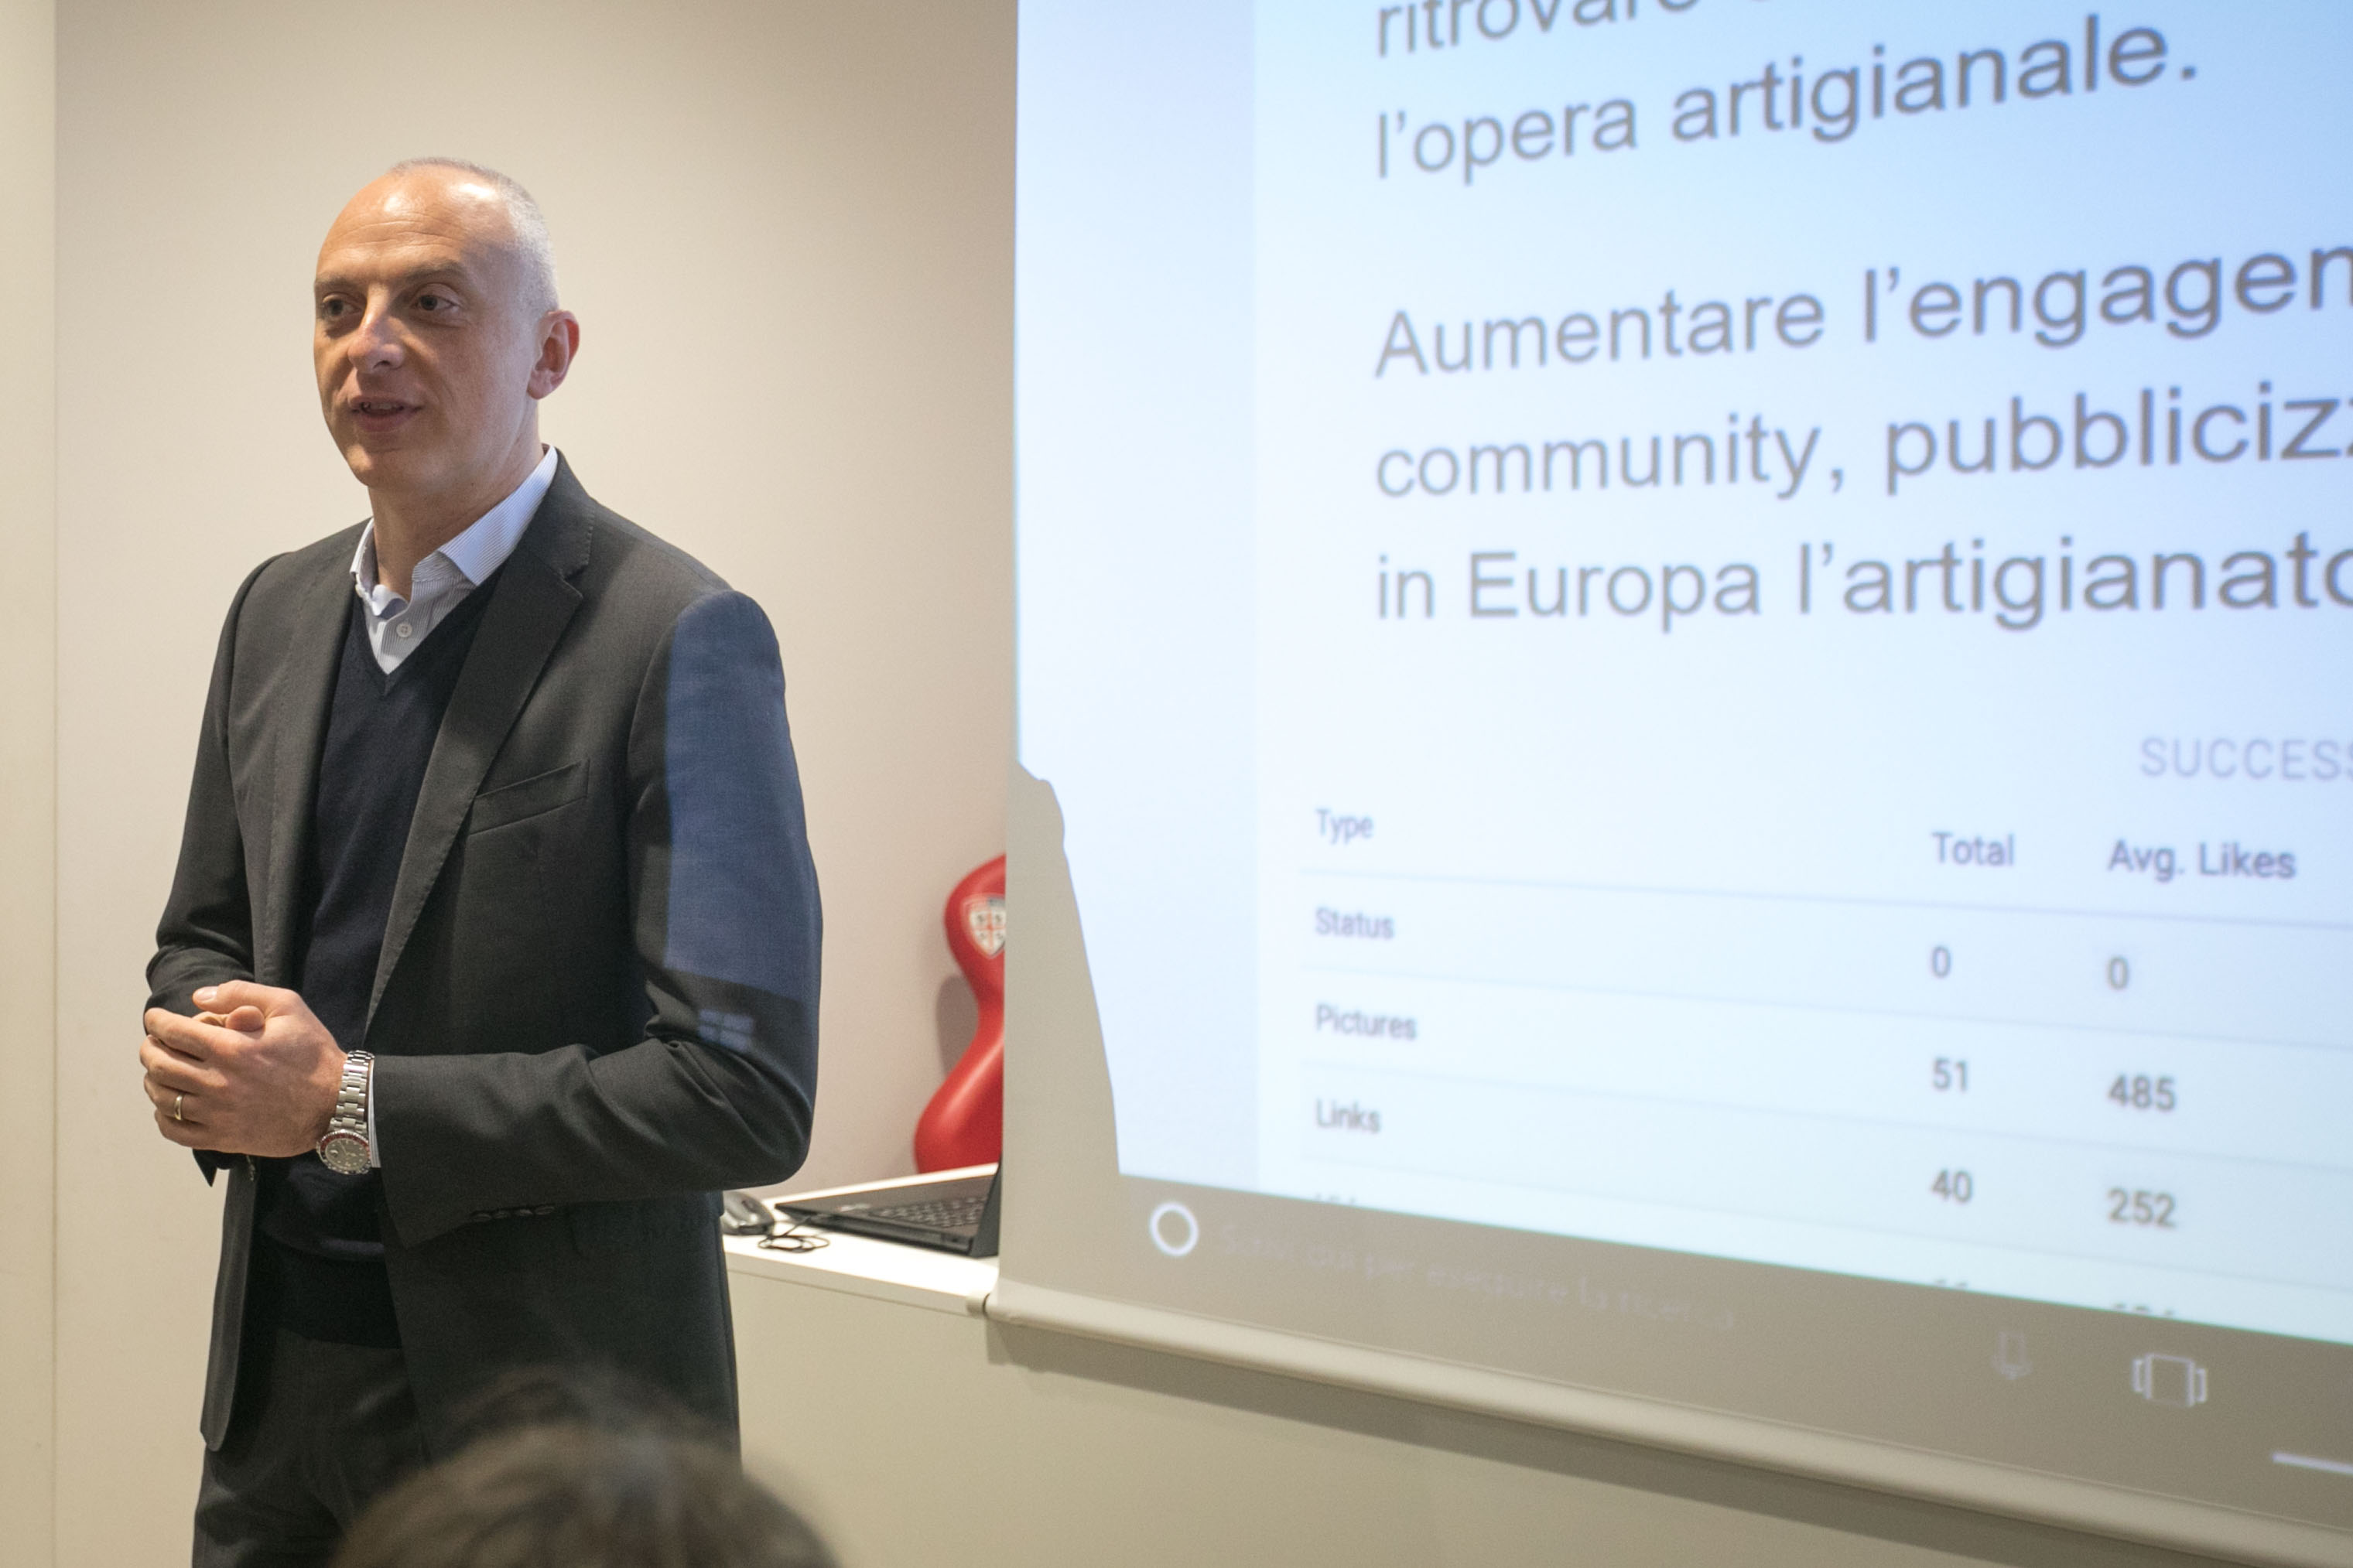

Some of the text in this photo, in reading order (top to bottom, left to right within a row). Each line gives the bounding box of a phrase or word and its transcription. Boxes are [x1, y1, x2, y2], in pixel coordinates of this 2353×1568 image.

[1378, 0, 1700, 58] ritrov
[1377, 12, 2198, 186] l’opera artigianale.
[1374, 289, 1826, 379] Aumentare
[1376, 380, 2353, 501] community, pubbliciz
[1377, 553, 1435, 619] in
[1469, 550, 1762, 634] Europa
[2139, 736, 2353, 782] SUCCES
[1315, 808, 2298, 883] Type Total Avg. Likes
[1315, 906, 2132, 992] Status 0 0
[1315, 1003, 2178, 1113] Pictures 51 485
[1315, 1099, 2178, 1230] Links 40 252
